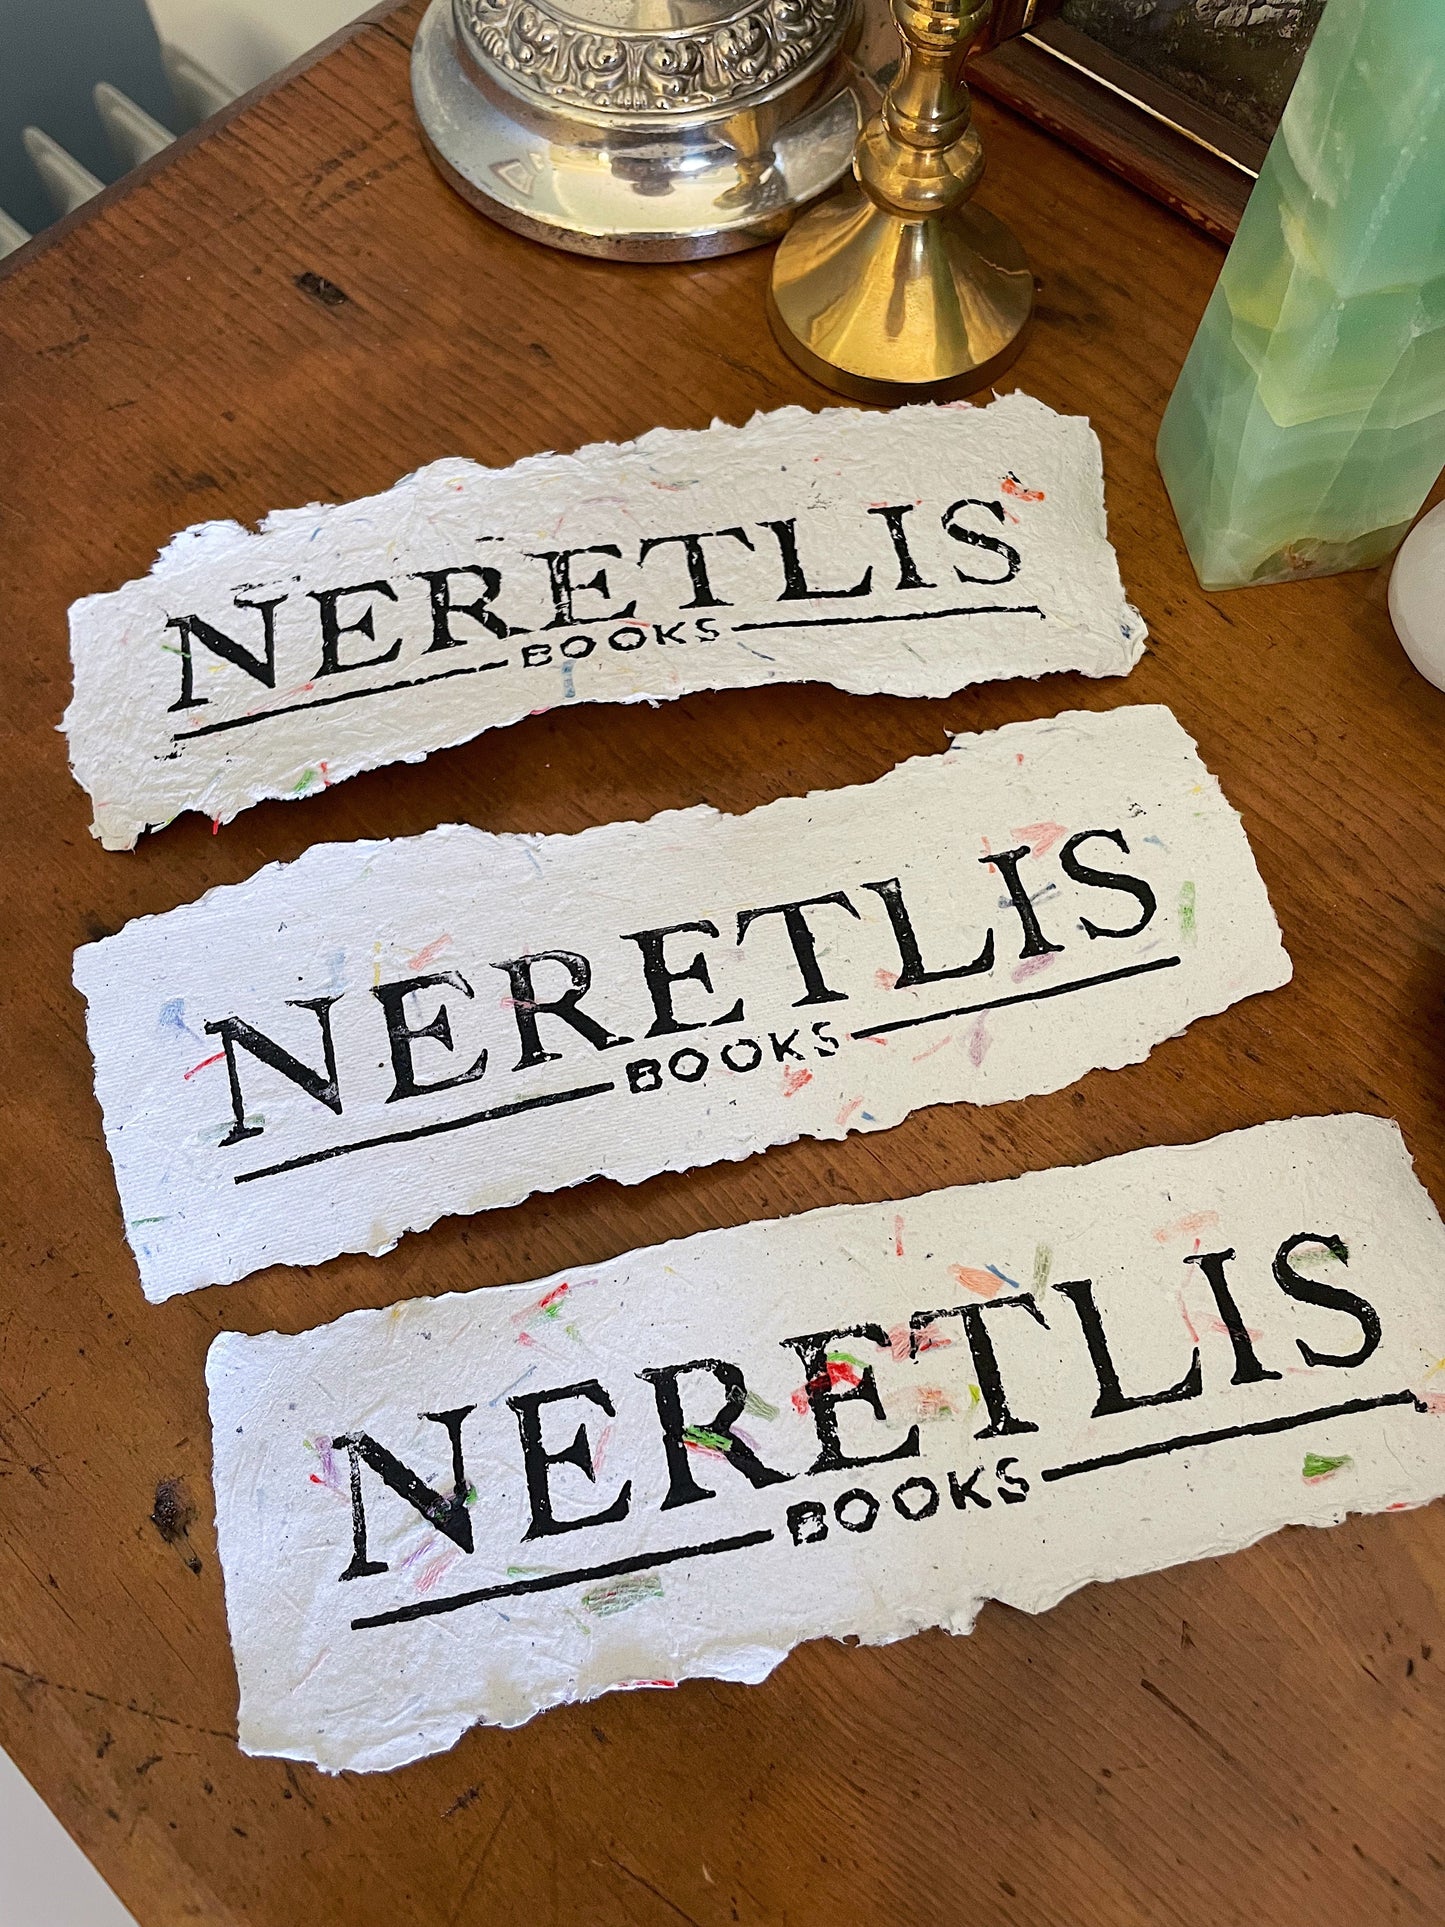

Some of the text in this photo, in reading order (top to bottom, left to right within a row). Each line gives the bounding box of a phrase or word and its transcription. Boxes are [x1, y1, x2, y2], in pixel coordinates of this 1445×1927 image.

[164, 498, 1021, 712] NERETLIS
[523, 618, 720, 667] BOOKS
[204, 829, 1157, 1147] NERETLIS
[626, 1022, 839, 1093] BOOKS
[331, 1232, 1383, 1582] NERETLIS
[786, 1457, 1029, 1545] BOOKS
